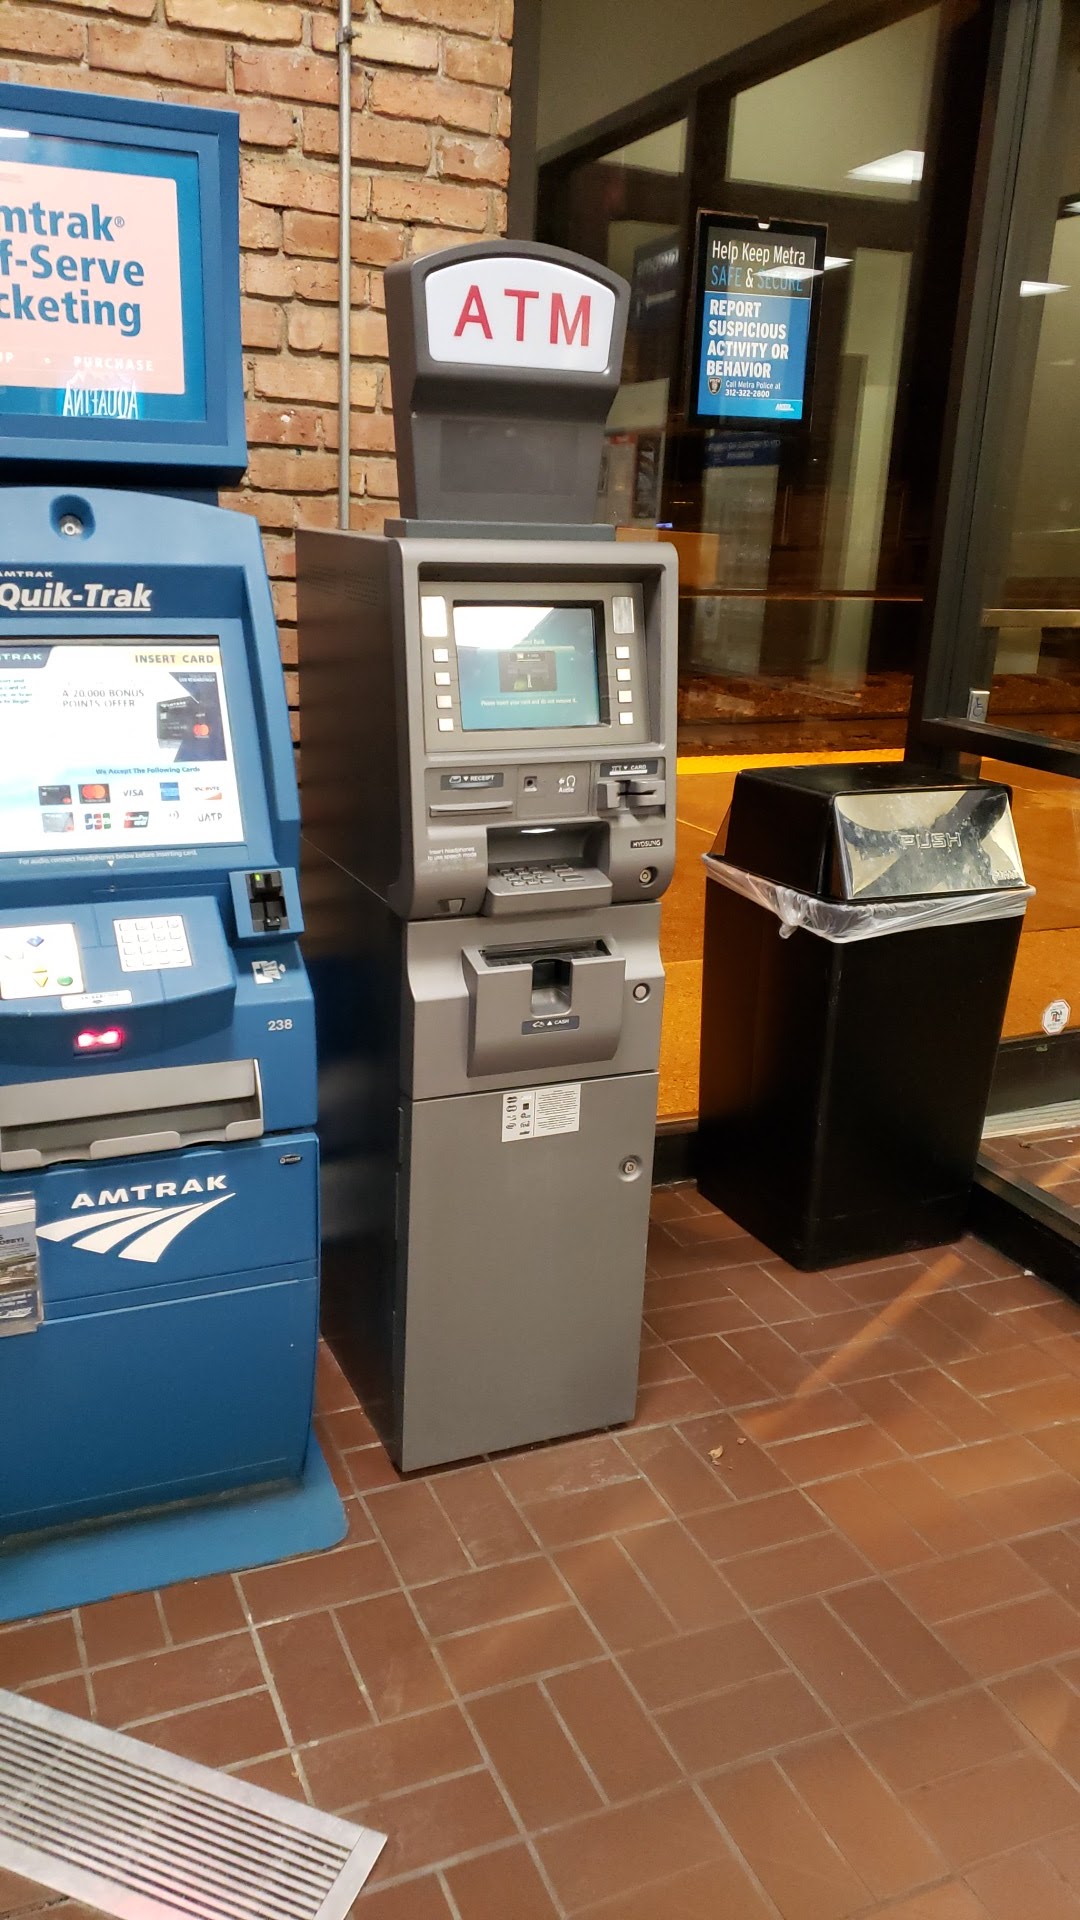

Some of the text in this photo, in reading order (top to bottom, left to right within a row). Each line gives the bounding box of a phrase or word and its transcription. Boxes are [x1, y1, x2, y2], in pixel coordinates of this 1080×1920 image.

[712, 240, 805, 266] Help Keep Metra
[711, 265, 742, 287] SAFE
[746, 268, 754, 288] &
[453, 284, 592, 347] ATM
[710, 299, 761, 318] REPORT
[708, 319, 787, 340] SUSPICIOUS
[707, 340, 789, 360] ACTIVITY OR
[73, 355, 154, 371] PURCHASE
[706, 360, 771, 378] BEHAVIOR
[725, 380, 736, 388] Call
[737, 380, 755, 389] Metra
[756, 381, 774, 389] Police
[725, 389, 770, 398] 312-322-2800
[0, 582, 152, 611] Quik-Trak
[135, 654, 214, 663] INSERT CARD
[62, 689, 69, 697] A
[109, 689, 144, 697] BONUS
[63, 699, 136, 708] POINTS OFFER
[108, 768, 132, 776] Accept
[470, 774, 495, 782] RECEIPT
[123, 789, 144, 797] VISA
[632, 839, 661, 848] HYOSUNG
[899, 831, 962, 849] PUSH
[268, 1018, 293, 1031] 238
[70, 1174, 228, 1209] AMTRAK
